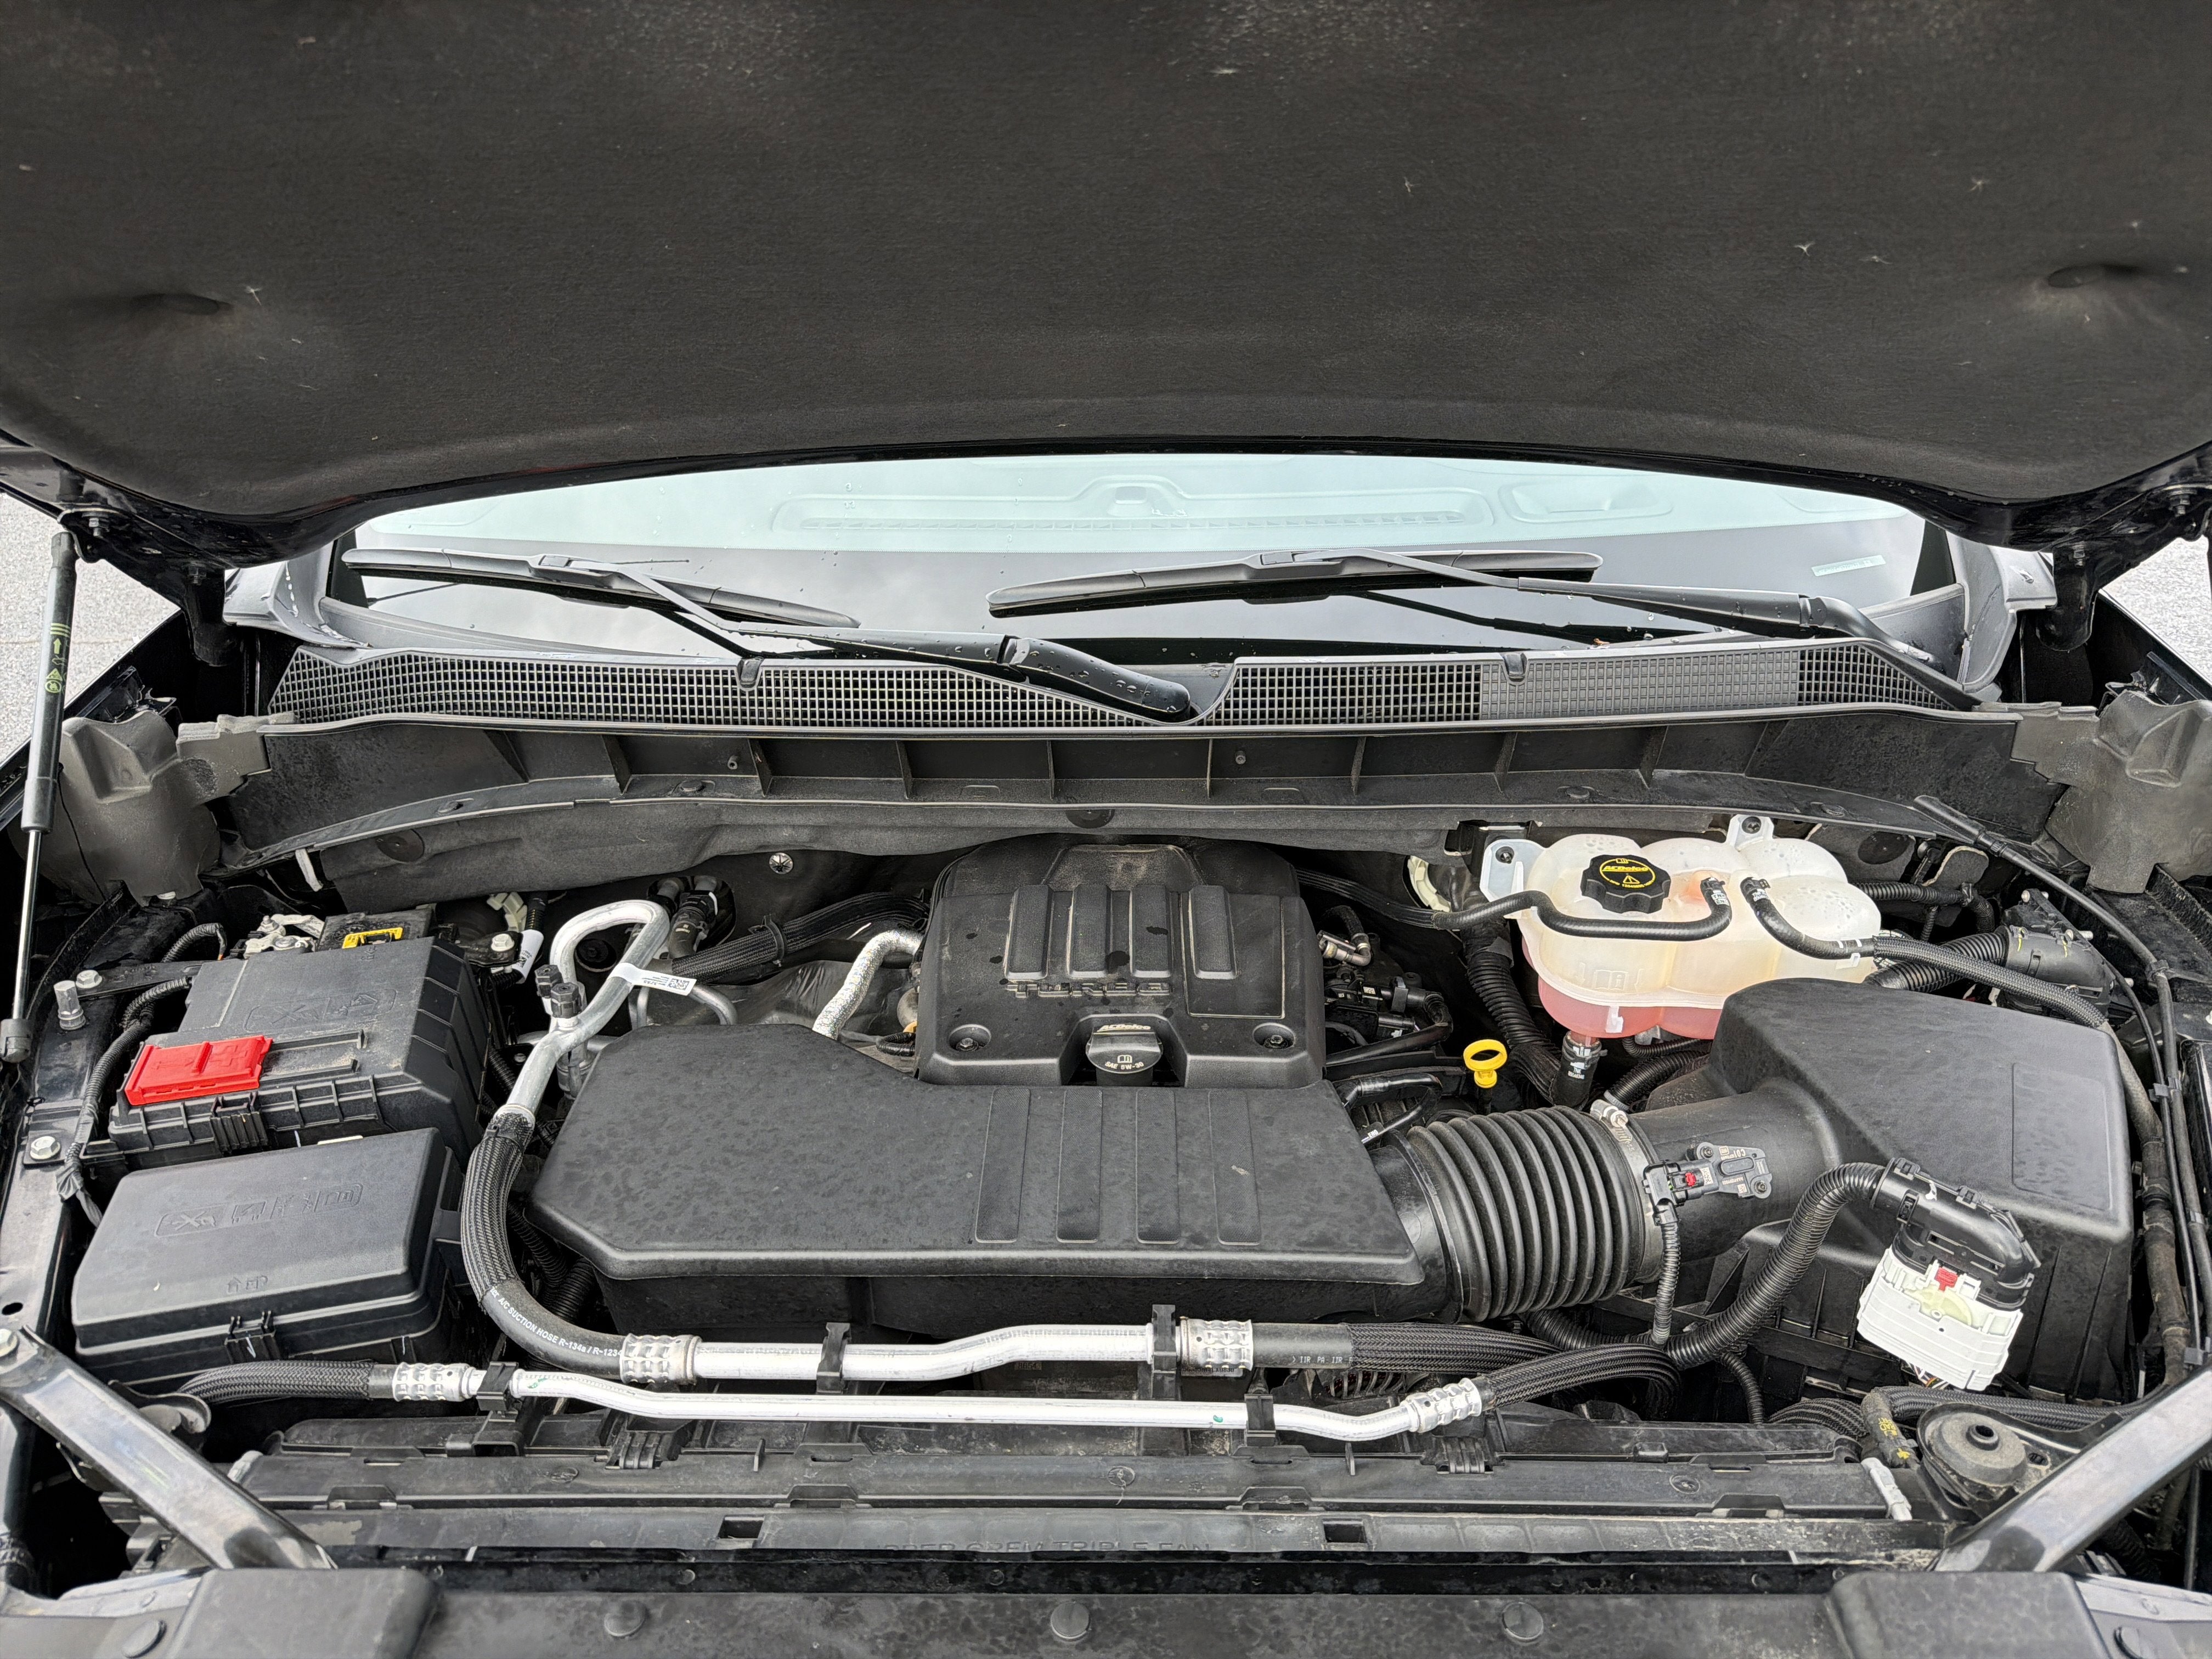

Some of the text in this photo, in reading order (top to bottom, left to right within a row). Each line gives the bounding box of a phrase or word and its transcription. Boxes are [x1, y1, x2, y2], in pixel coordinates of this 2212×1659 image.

[1098, 1024, 1152, 1032] ACDelco
[1104, 1061, 1144, 1070] SAE 5W-30
[498, 1297, 510, 1310] A/C
[507, 1307, 538, 1333] SUCTION
[536, 1328, 559, 1344] HOSE
[558, 1338, 586, 1353] R-134a
